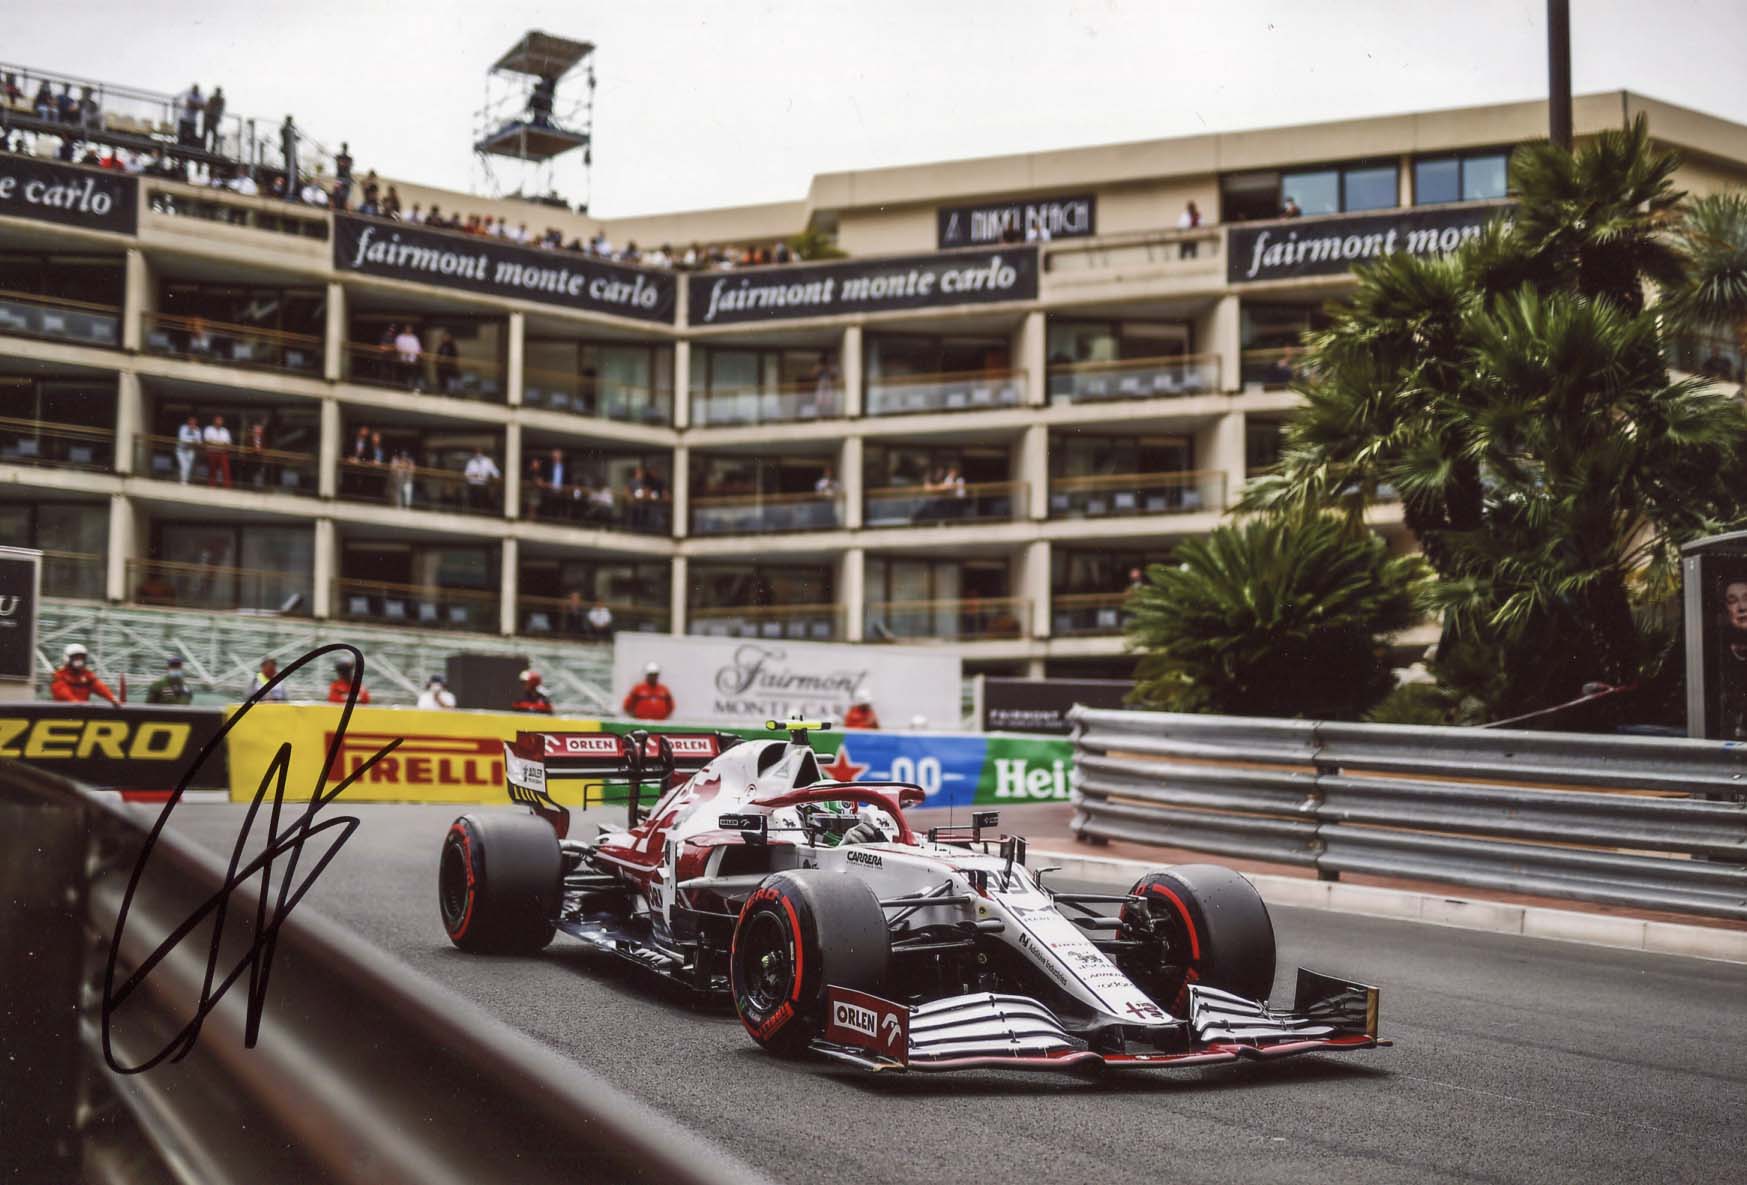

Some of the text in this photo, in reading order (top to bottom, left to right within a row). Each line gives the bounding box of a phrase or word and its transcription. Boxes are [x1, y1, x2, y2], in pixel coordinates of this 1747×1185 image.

[25, 177, 112, 215] carlo
[352, 226, 659, 308] fairmont monte carlo
[1246, 222, 1483, 278] fairmont mon
[704, 255, 1017, 322] fairmont monte carlo
[714, 643, 868, 700] Fairmont
[0, 718, 191, 760] ZERO
[325, 732, 504, 787] PIRELLI
[569, 739, 614, 750] ORLEN
[994, 758, 1073, 799] Hei
[847, 850, 883, 867] CARRERA
[836, 1005, 876, 1033] ORLEN
